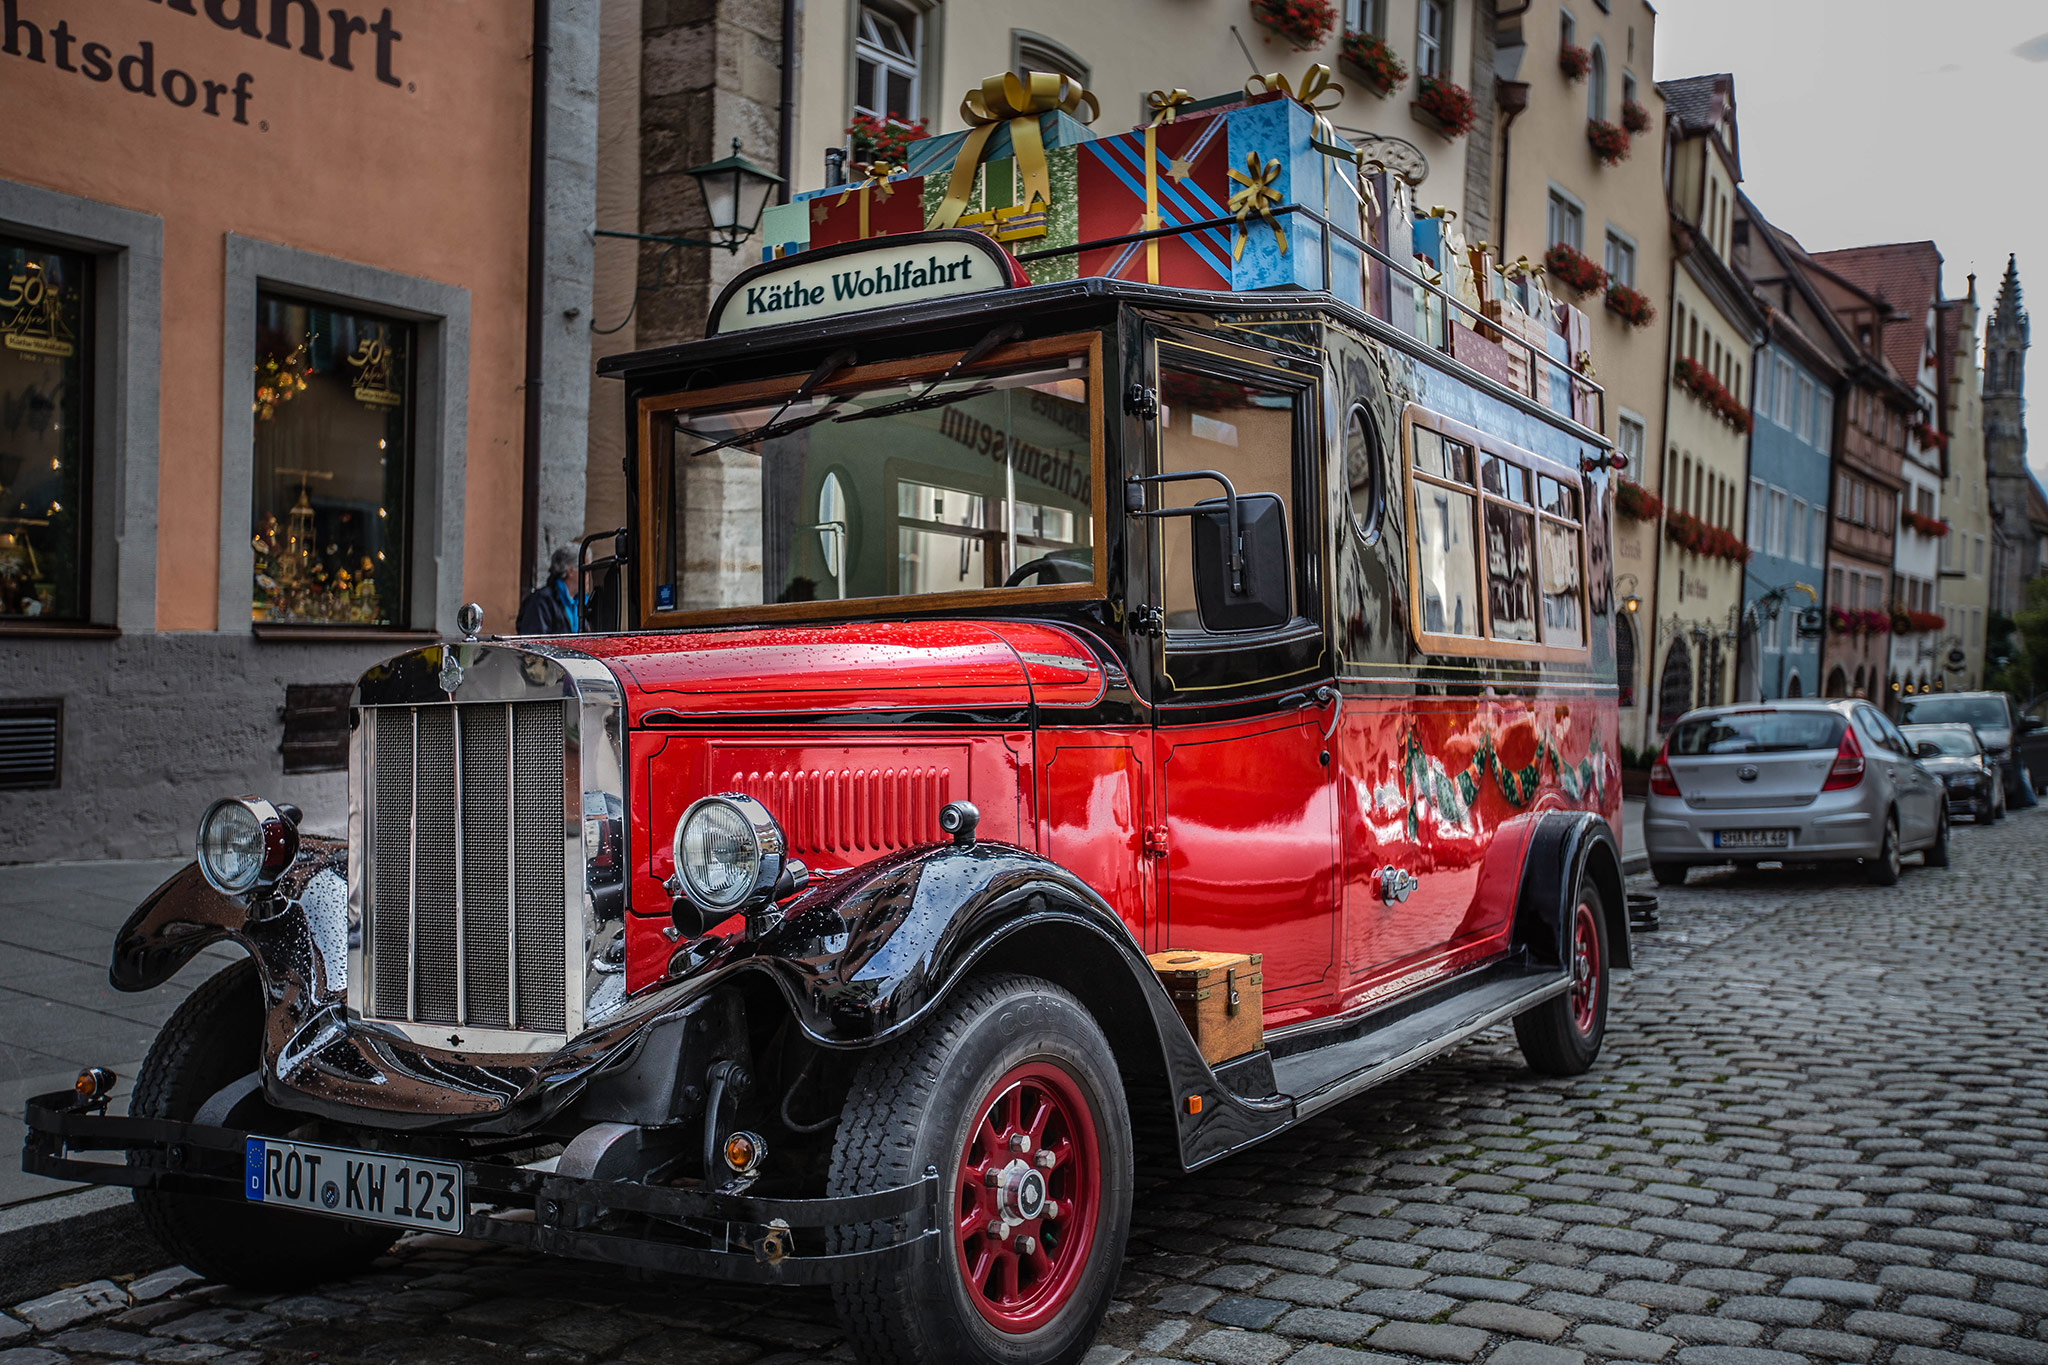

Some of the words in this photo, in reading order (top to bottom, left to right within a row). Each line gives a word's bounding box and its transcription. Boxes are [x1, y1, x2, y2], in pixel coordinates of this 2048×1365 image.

[0, 275, 44, 307] 50
[746, 280, 825, 315] Käthe
[832, 254, 972, 301] Wohlfahrt
[347, 339, 382, 366] 50
[252, 1176, 259, 1189] D
[265, 1149, 321, 1202] ROT
[346, 1160, 386, 1213] KW
[394, 1167, 456, 1222] 123
